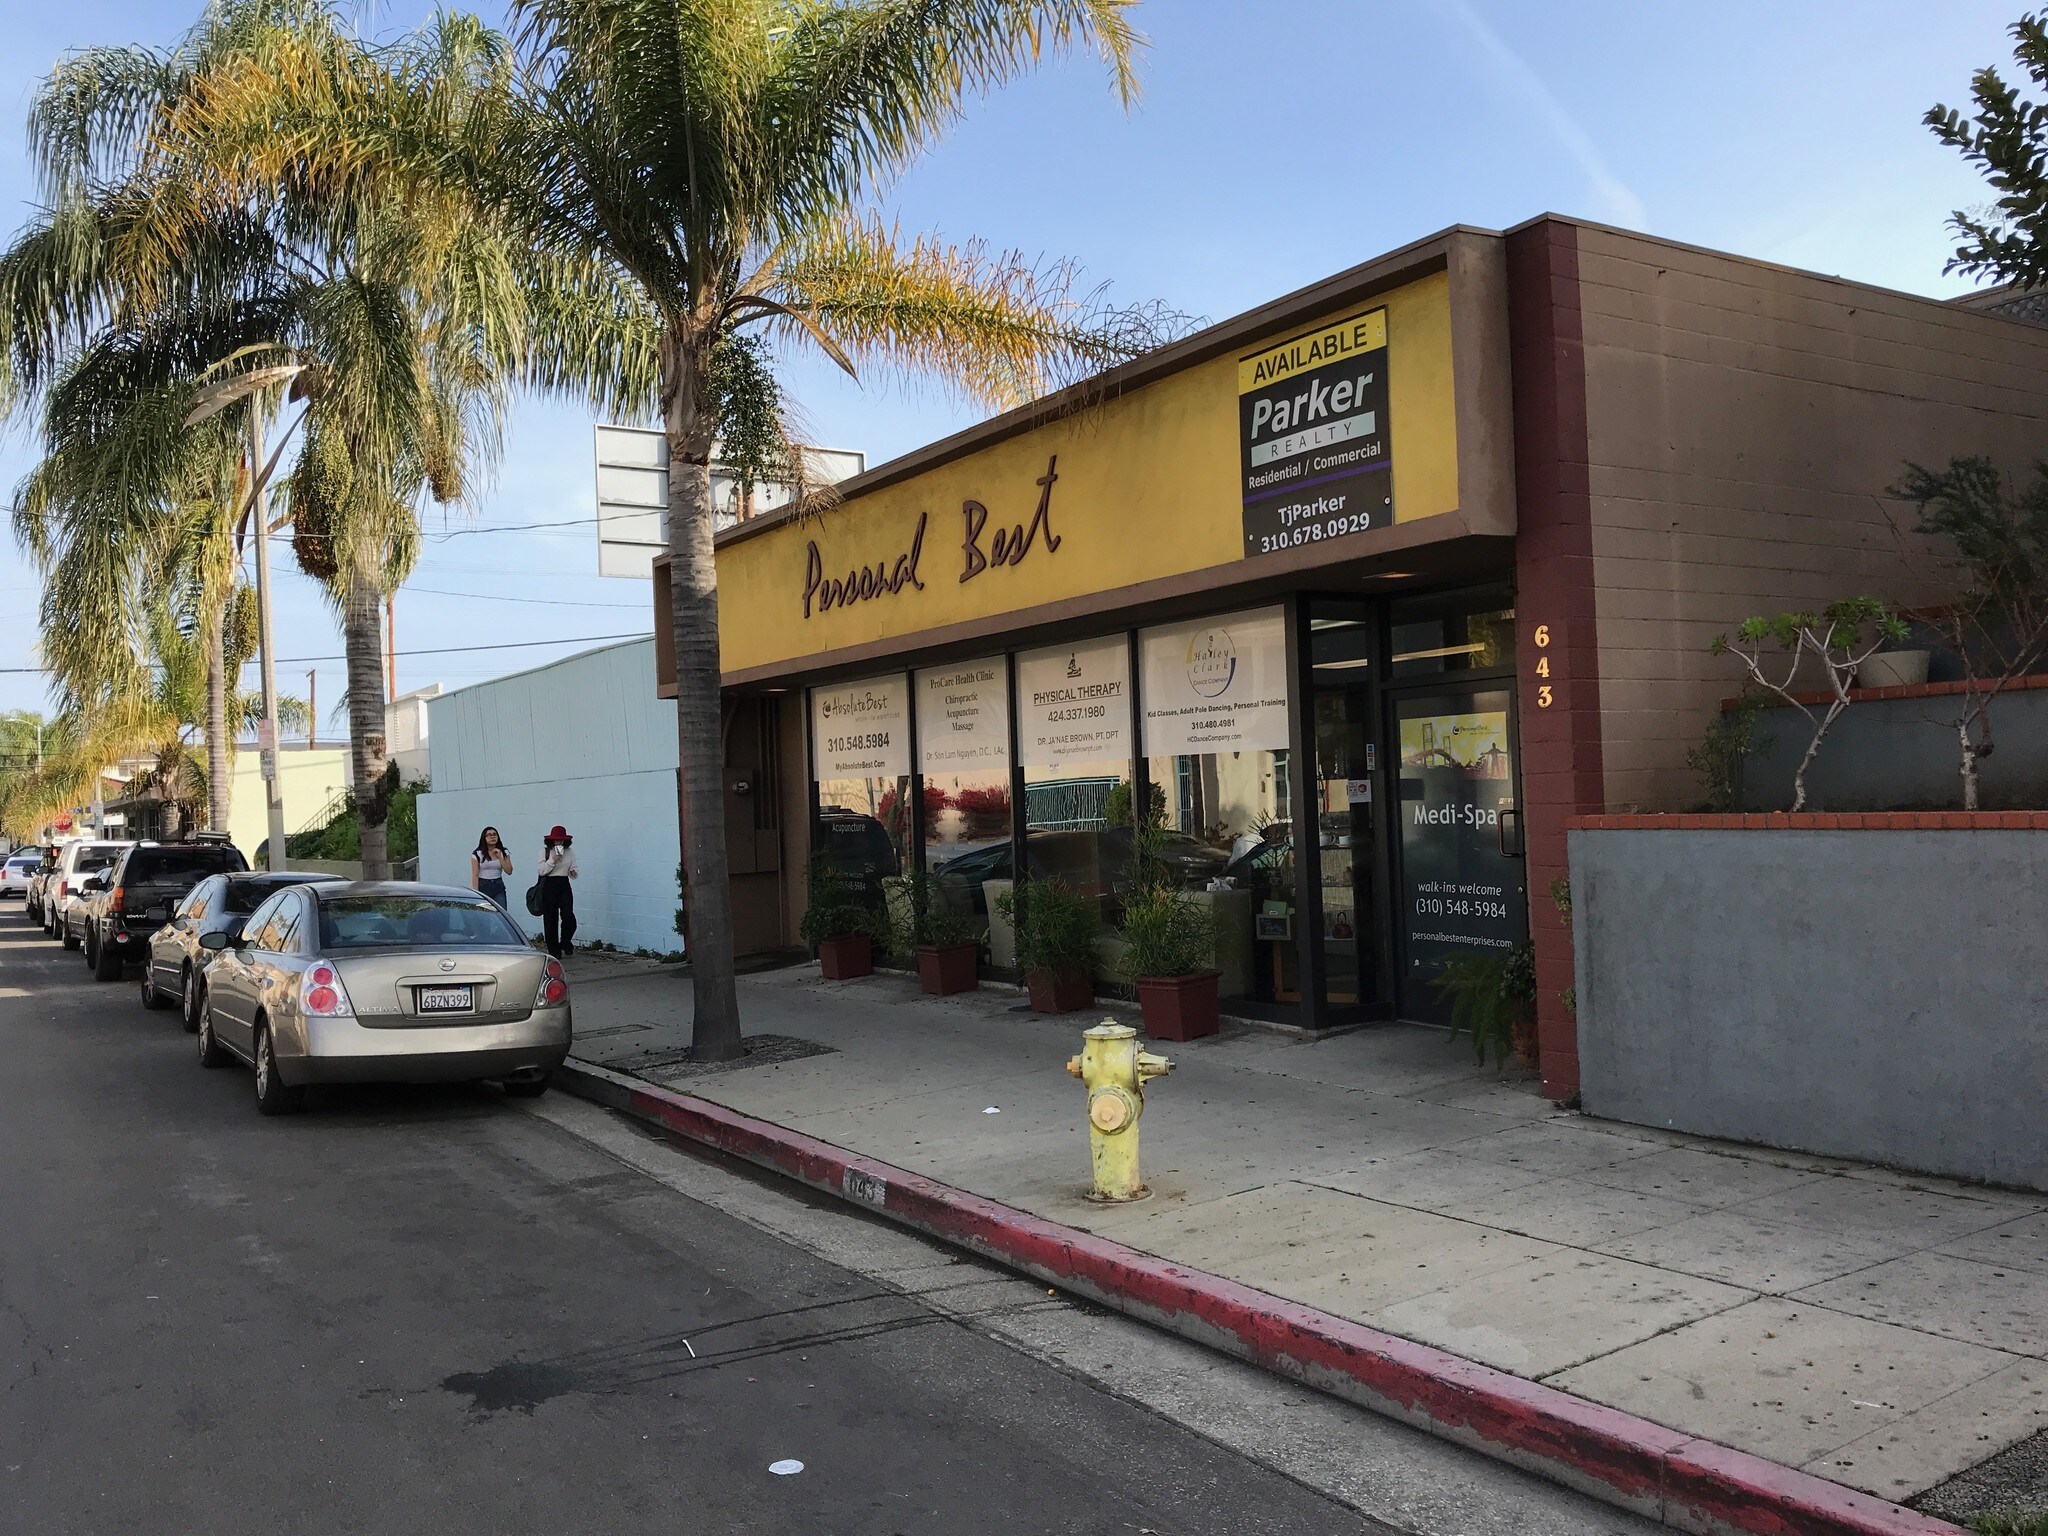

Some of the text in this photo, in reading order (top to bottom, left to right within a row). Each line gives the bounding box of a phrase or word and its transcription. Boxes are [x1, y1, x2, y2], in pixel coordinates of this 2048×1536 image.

[1253, 323, 1367, 384] AVAILABLE
[1251, 372, 1373, 439] Parker
[1271, 422, 1352, 457] REALTY
[1249, 462, 1300, 489] Residential
[1313, 441, 1381, 470] Commercial
[1278, 496, 1346, 526] TjParker
[802, 455, 1061, 619] Personal Best
[1261, 512, 1370, 553] 310.678.0929
[1193, 661, 1229, 673] Clark
[930, 670, 994, 689] ProCare Health Clinic
[945, 692, 978, 705] Chiropractic
[1033, 681, 1121, 704] PHYSICAL THERAPY
[946, 707, 979, 719] Acupuncture
[1048, 705, 1105, 722] 424.337.1980
[1180, 707, 1194, 715] Adult
[1195, 706, 1207, 714] Pole
[1234, 701, 1259, 709] Personal
[1260, 699, 1286, 708] Training
[952, 722, 974, 731] Massage
[1106, 730, 1119, 739] DPT
[828, 732, 889, 752] 310.548.5984
[1414, 804, 1498, 830] Medi-Spa
[832, 823, 866, 834] Acupuncture
[1418, 881, 1502, 896] walk-ins welcome
[1416, 898, 1507, 918] (310) 548-5984
[1412, 932, 1512, 949] personalbestenterprises.com
[423, 994, 469, 1009] 6BZN399
